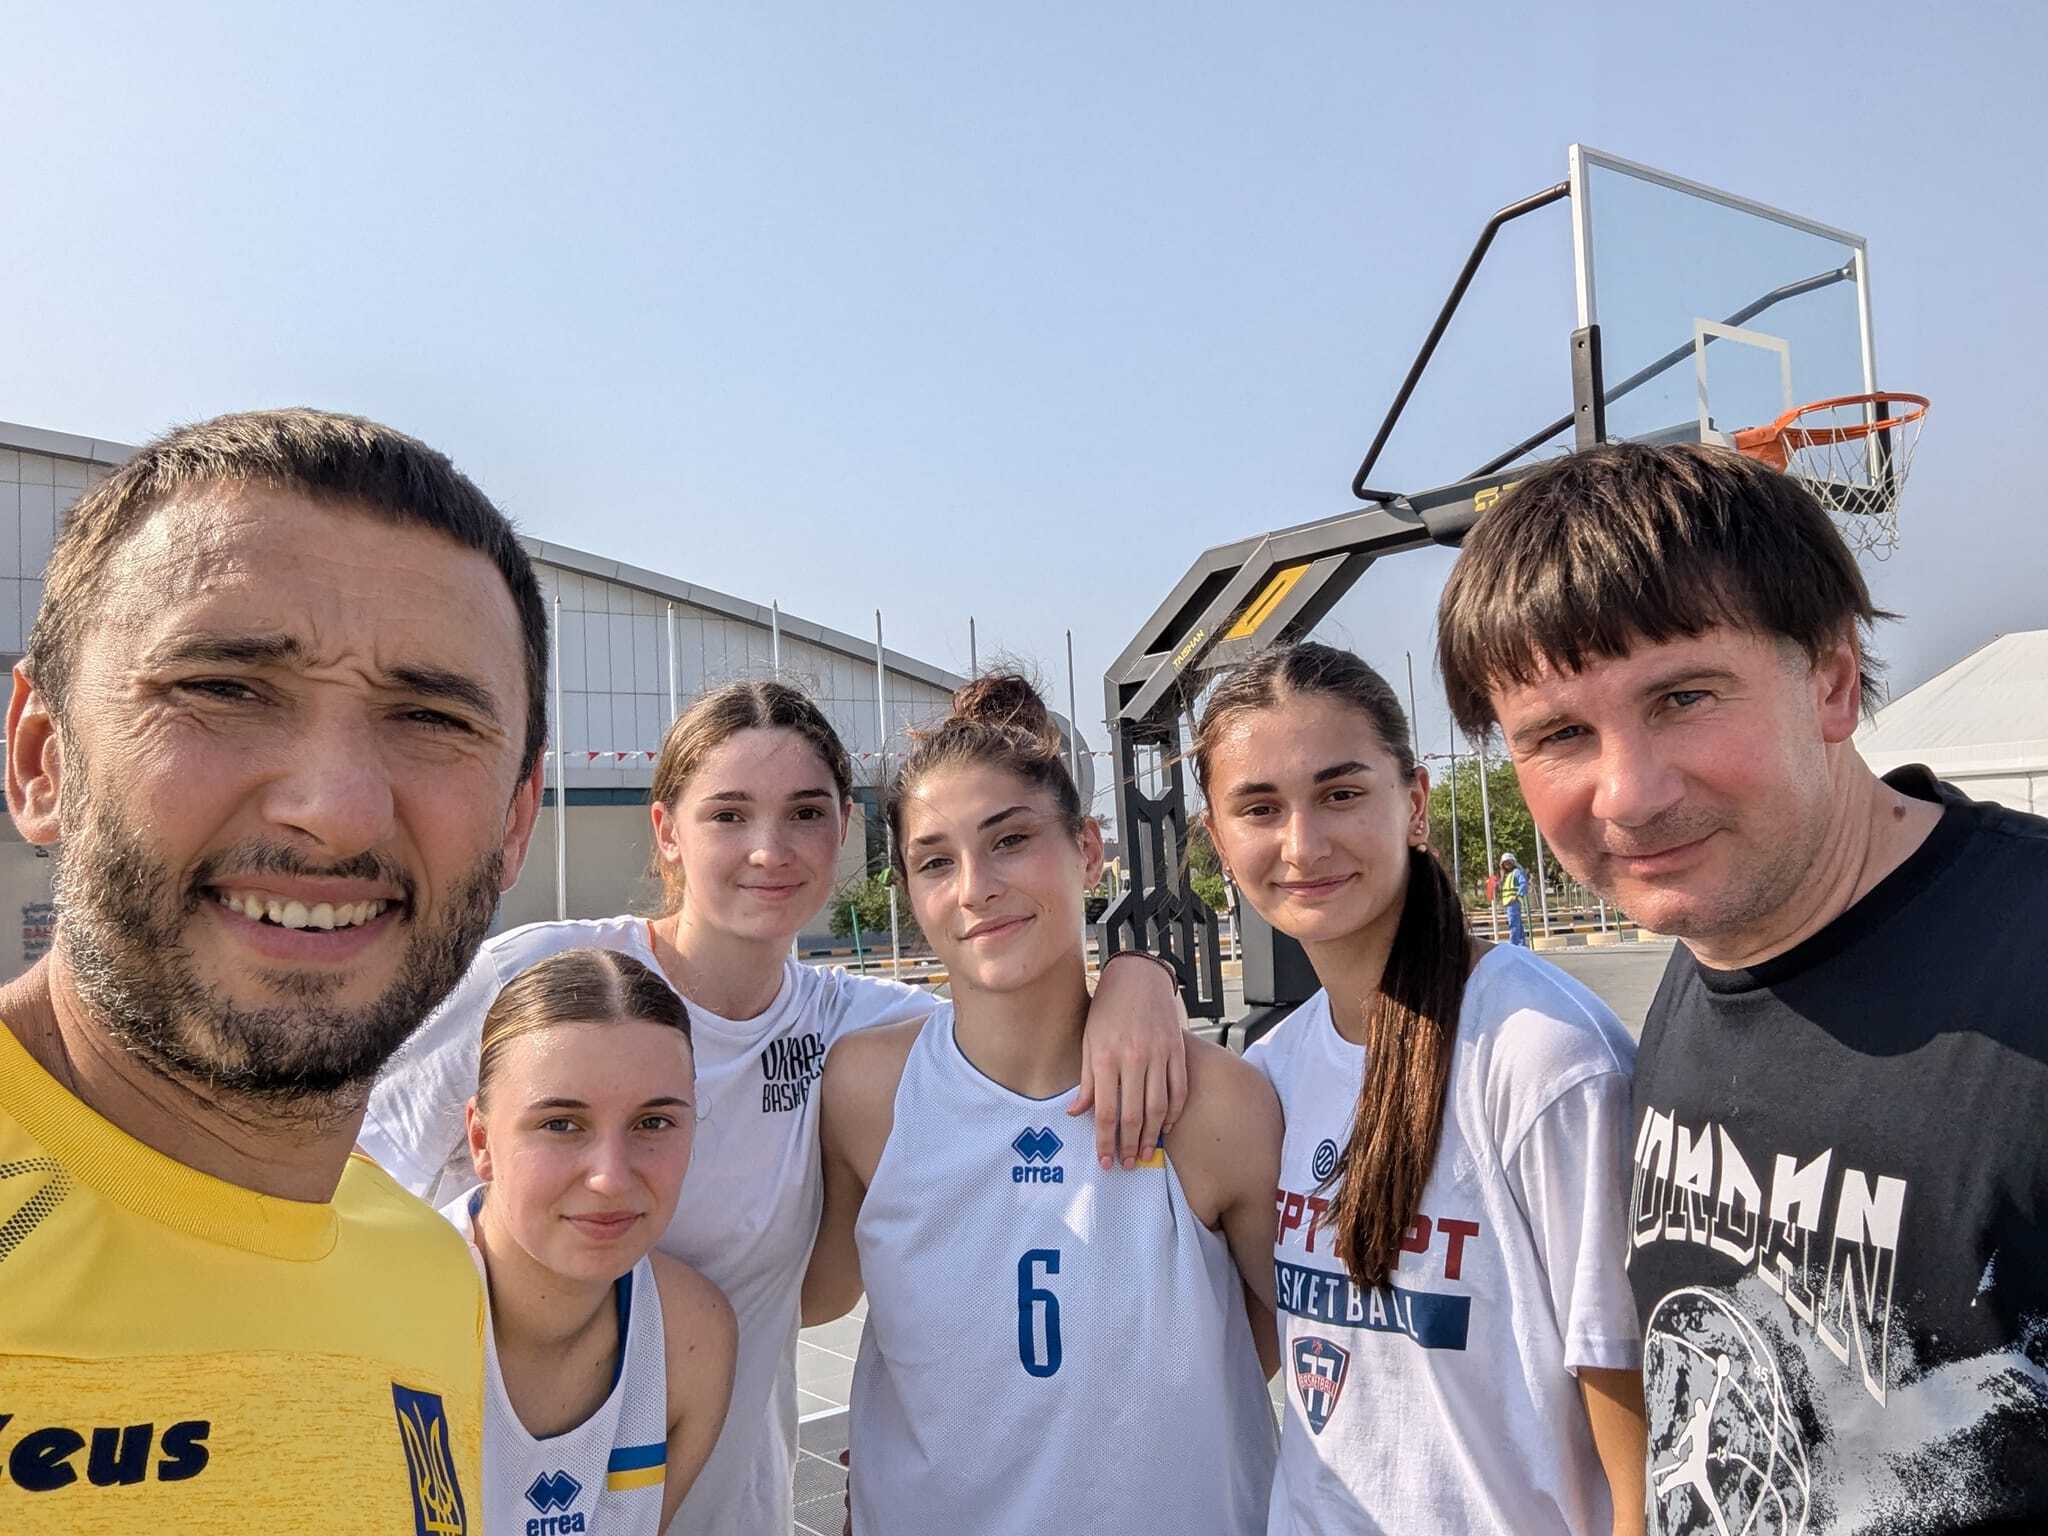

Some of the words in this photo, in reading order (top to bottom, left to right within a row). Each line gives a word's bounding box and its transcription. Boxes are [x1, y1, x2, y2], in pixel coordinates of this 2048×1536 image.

[1172, 629, 1205, 666] TAISHAN
[1012, 1165, 1064, 1184] errea
[1018, 1248, 1063, 1378] 6
[1753, 1364, 1769, 1382] 45
[0, 1413, 211, 1492] eus
[526, 1511, 586, 1536] errea
